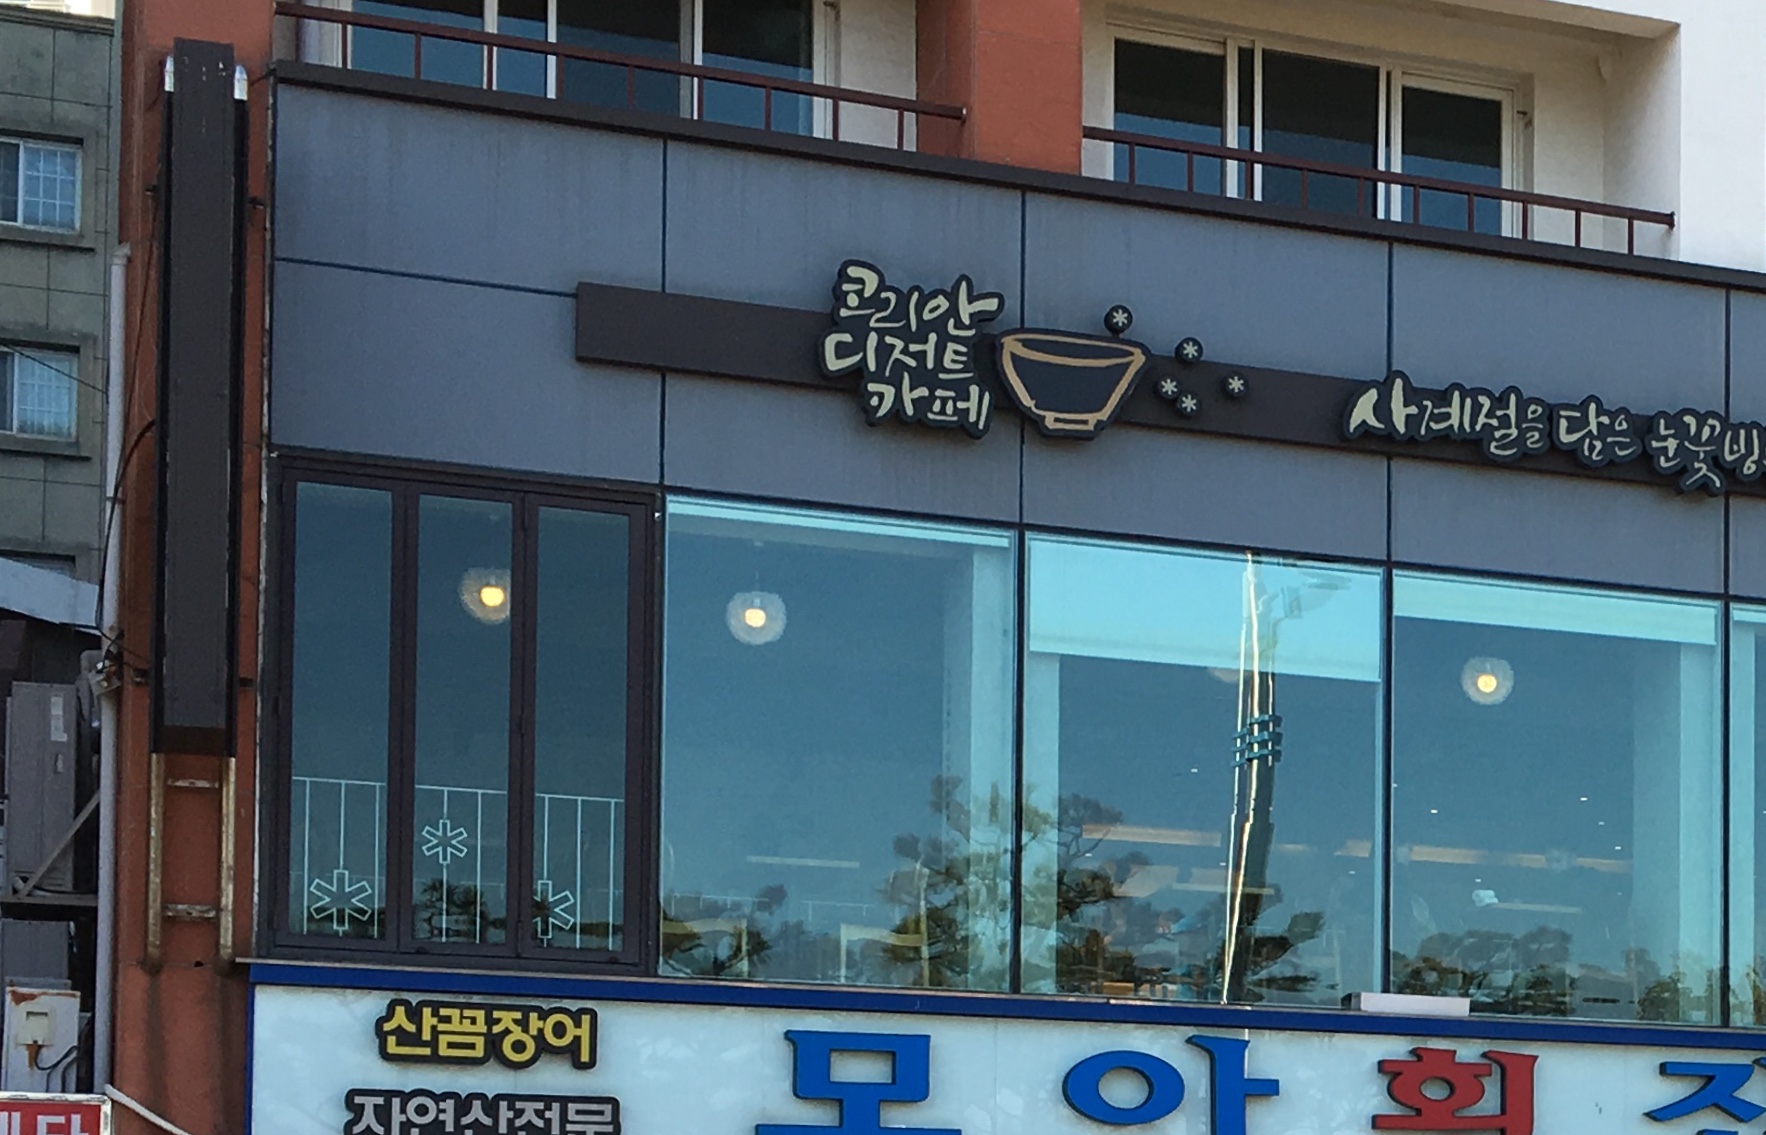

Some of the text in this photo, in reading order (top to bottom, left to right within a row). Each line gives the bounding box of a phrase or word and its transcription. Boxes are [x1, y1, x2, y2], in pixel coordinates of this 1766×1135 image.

[839, 265, 998, 337] 코리안
[824, 332, 975, 380] 디저트
[866, 372, 990, 431] 카페
[1349, 377, 1545, 456] 사계절을
[1558, 402, 1639, 458] 담은
[382, 1007, 592, 1065] 산꼼장어
